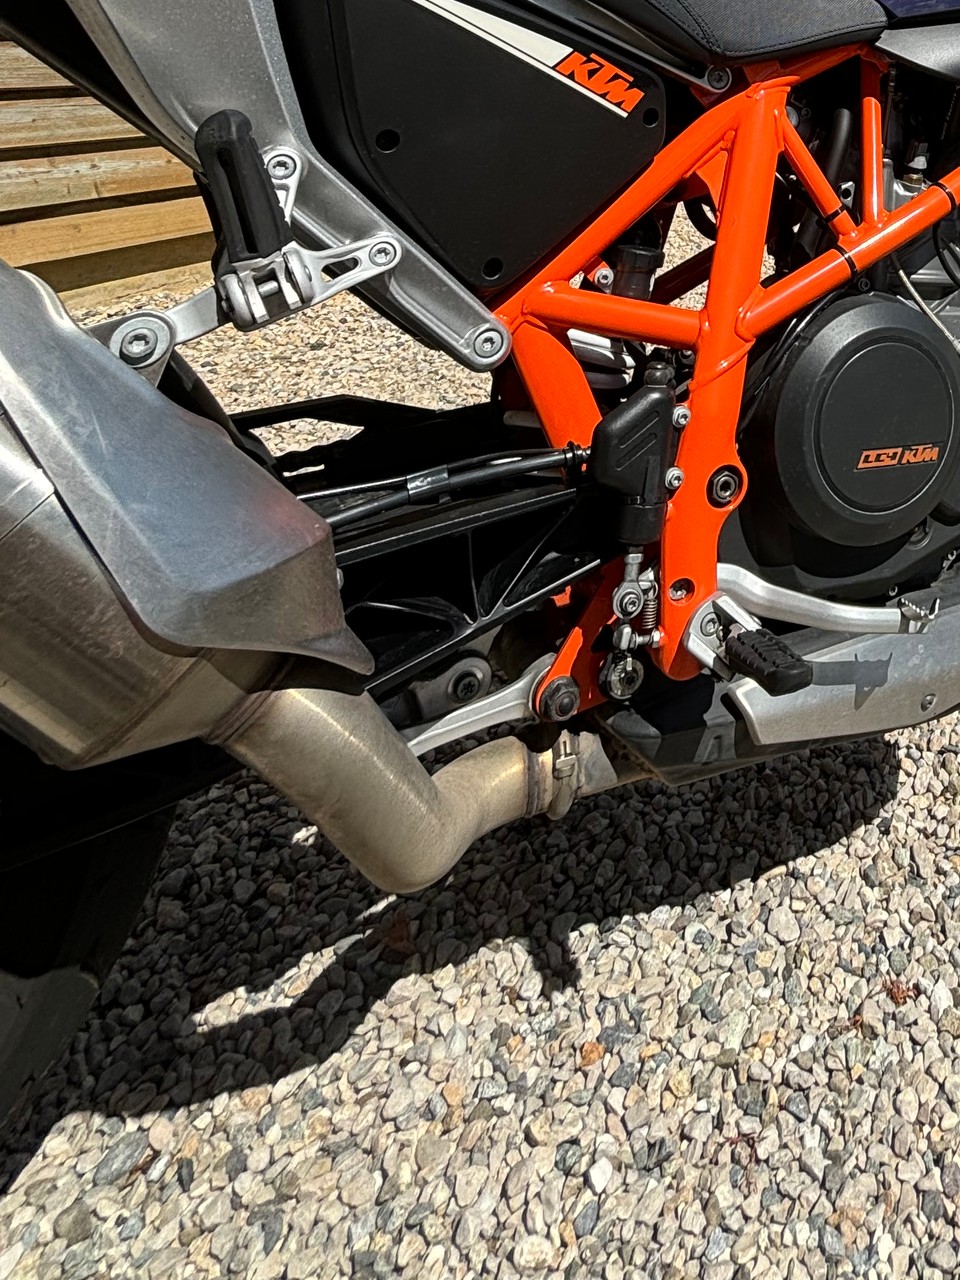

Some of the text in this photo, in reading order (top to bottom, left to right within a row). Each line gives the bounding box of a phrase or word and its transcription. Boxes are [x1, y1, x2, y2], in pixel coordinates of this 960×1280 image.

[555, 51, 645, 113] KTM
[860, 444, 939, 466] LC4 KTM
